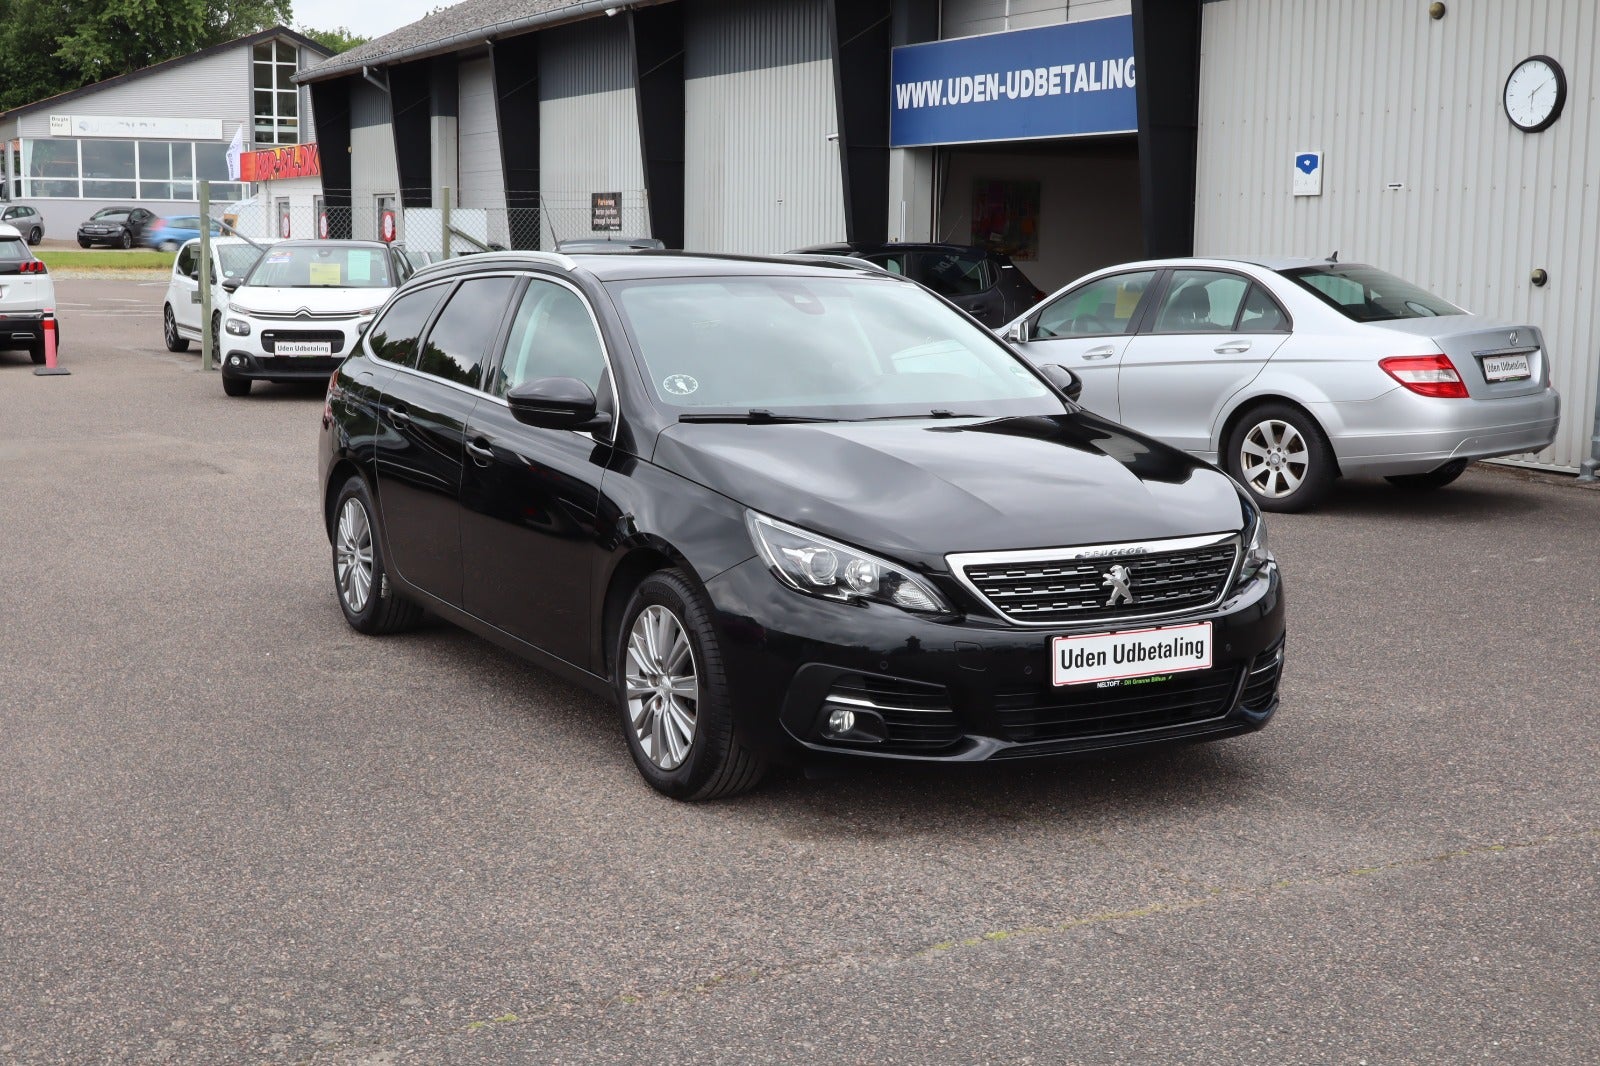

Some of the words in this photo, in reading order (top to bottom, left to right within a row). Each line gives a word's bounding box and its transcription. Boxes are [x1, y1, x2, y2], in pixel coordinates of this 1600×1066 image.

[895, 56, 1136, 110] WWW.UDEN-UDBETALING
[1487, 362, 1500, 373] Uden
[1084, 547, 1144, 558] PEUGEOT
[1061, 648, 1107, 670] Uden
[1113, 636, 1204, 665] Udbetaling
[1096, 680, 1120, 689] NELTOFT
